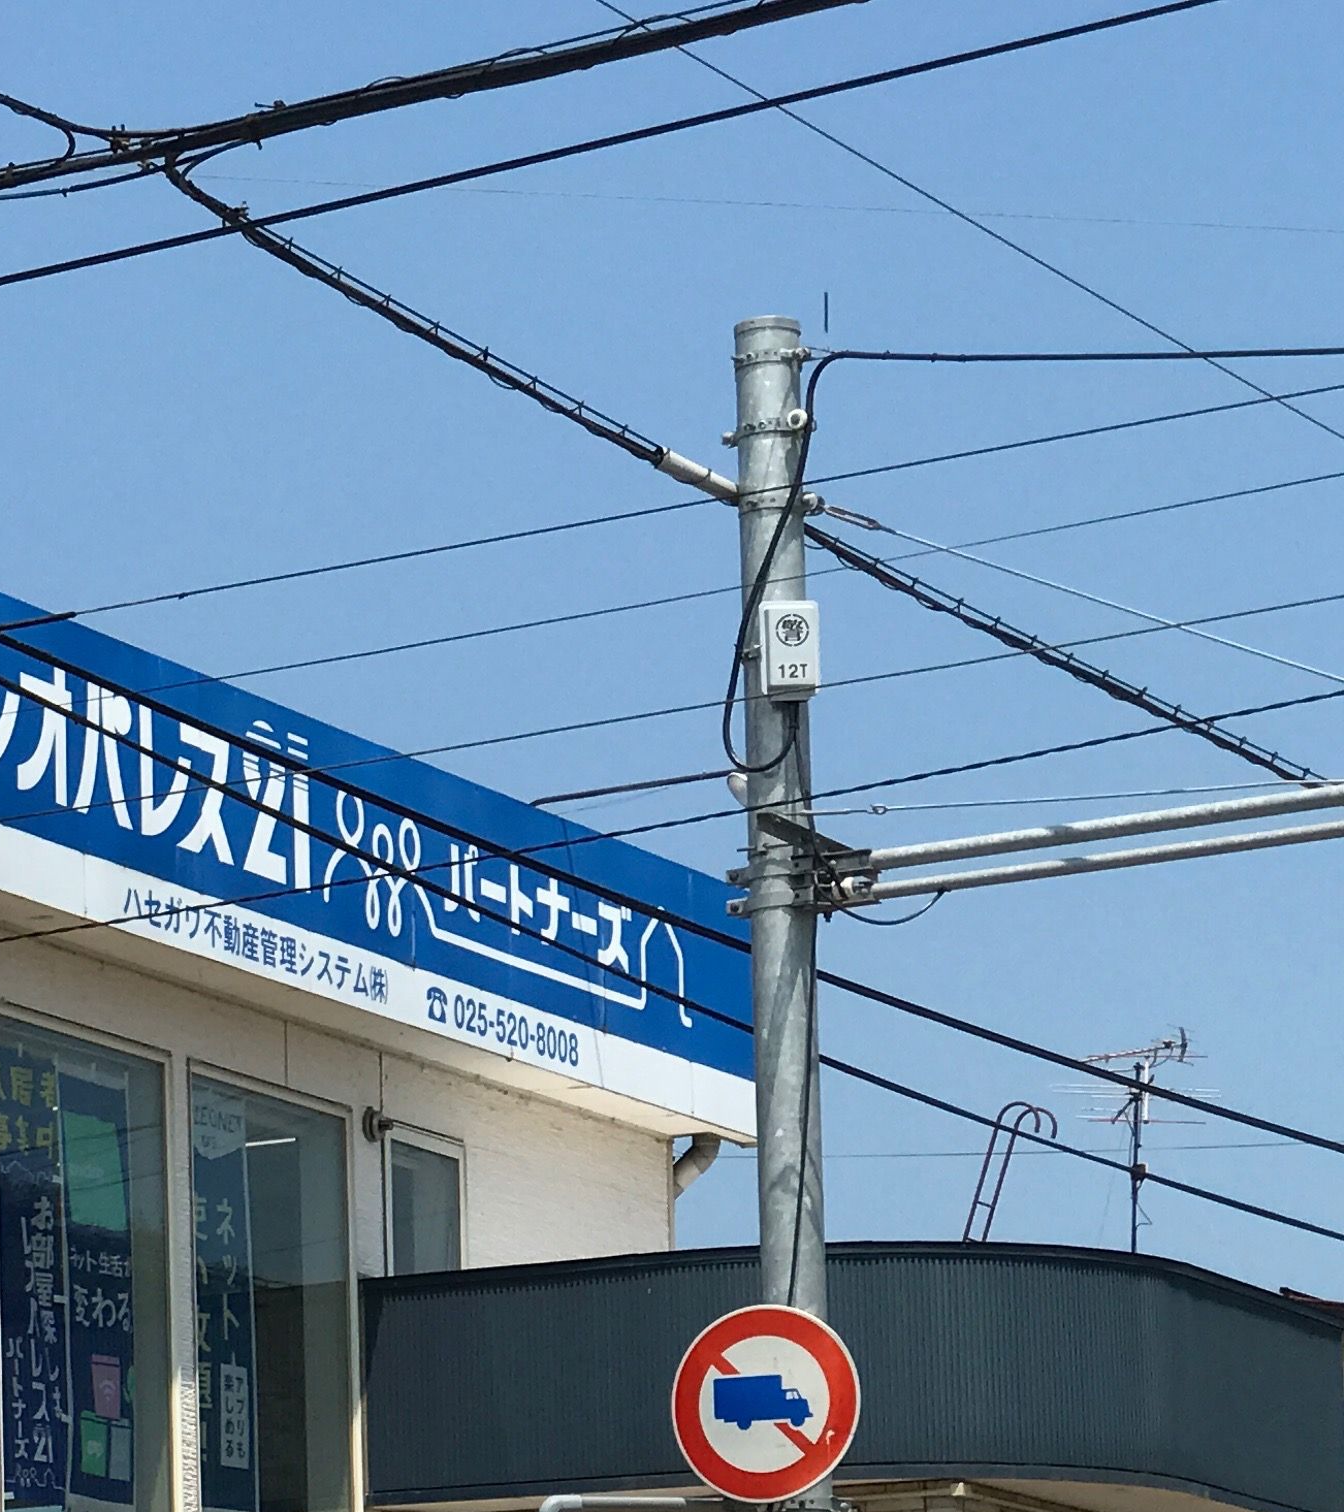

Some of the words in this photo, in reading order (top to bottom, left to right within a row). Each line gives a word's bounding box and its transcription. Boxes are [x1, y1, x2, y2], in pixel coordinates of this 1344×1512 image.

[443, 842, 633, 974] パートナーズ
[454, 992, 580, 1067] 025-520-8008
